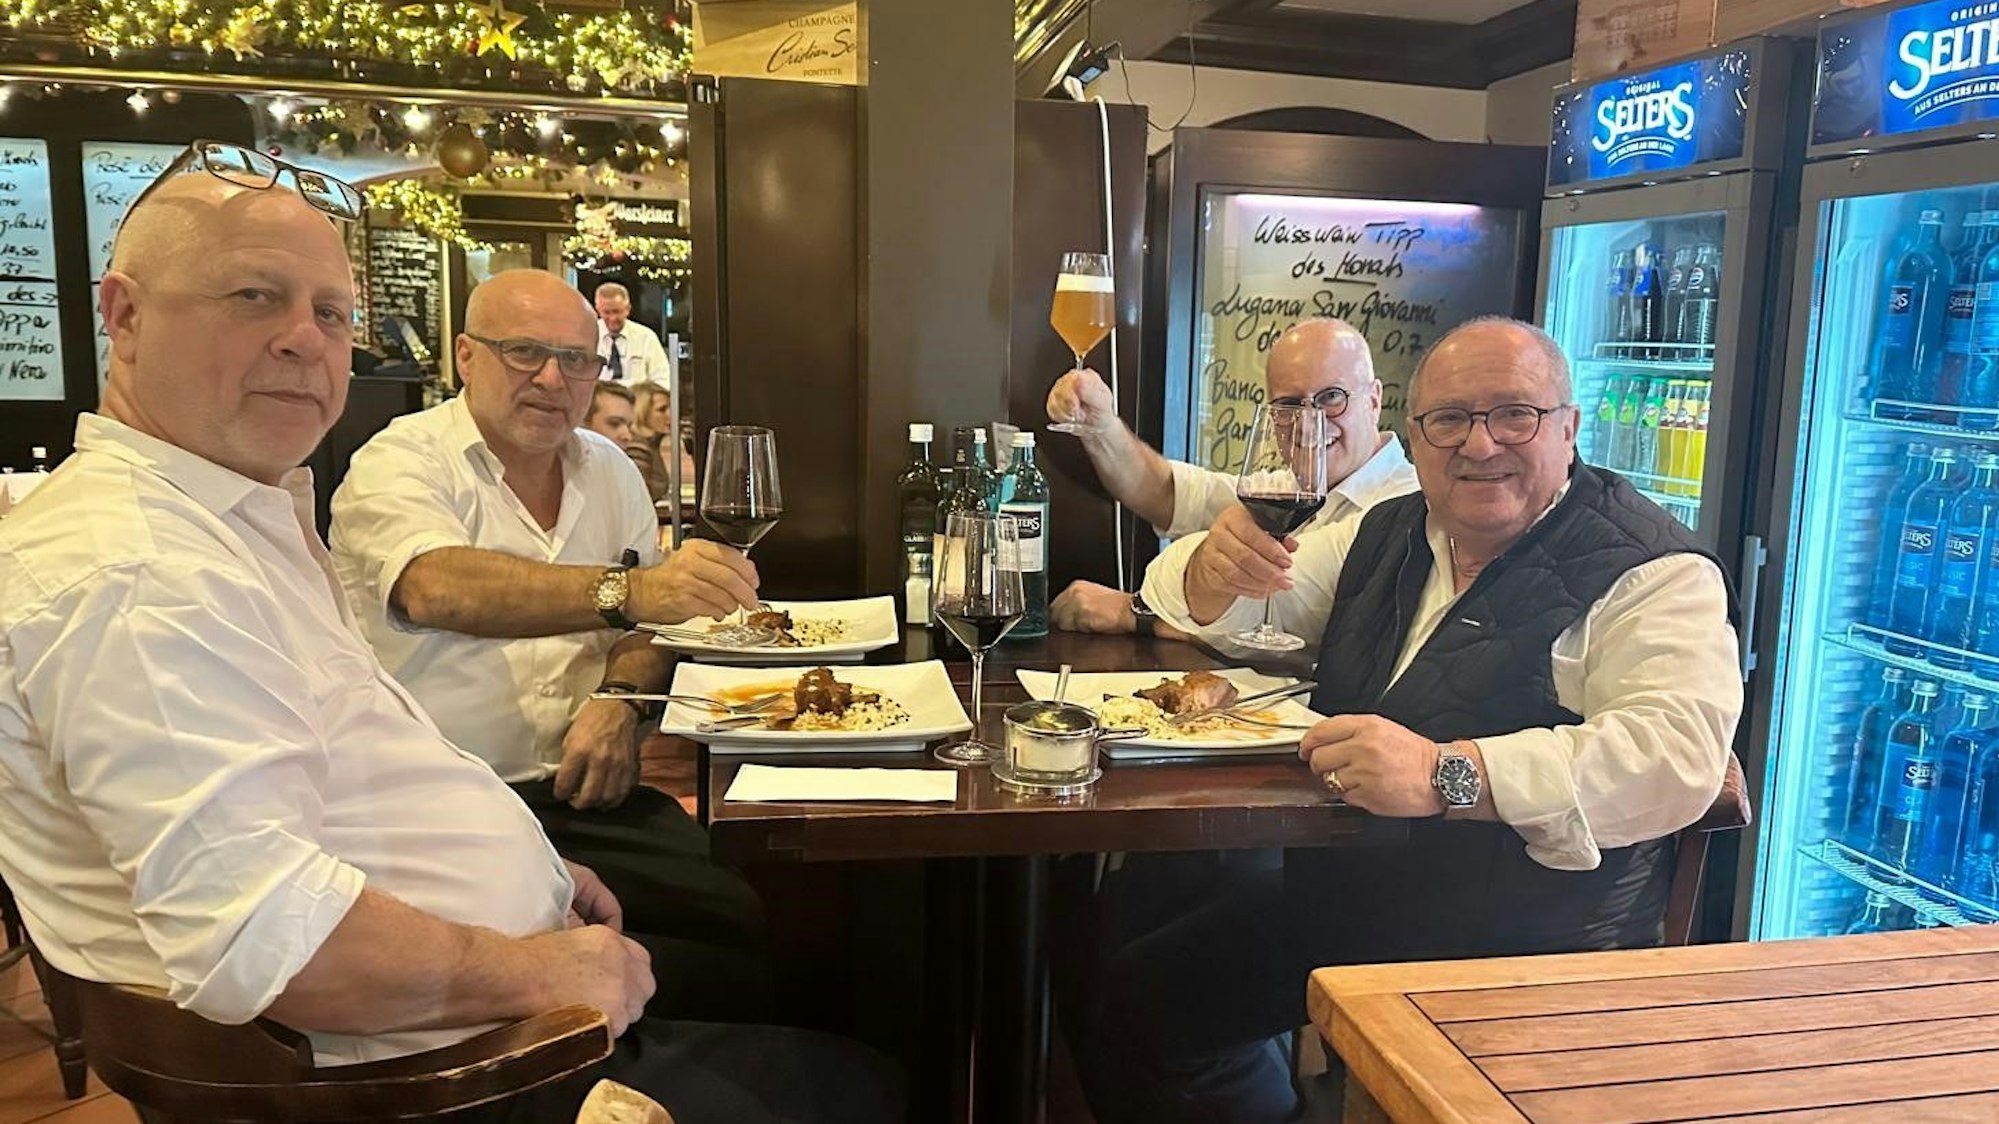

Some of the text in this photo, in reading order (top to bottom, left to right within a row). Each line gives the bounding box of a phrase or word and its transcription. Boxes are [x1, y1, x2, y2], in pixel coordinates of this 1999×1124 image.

[1592, 82, 1695, 152] SELTERS
[1914, 97, 1932, 115] AUS
[1933, 85, 1973, 105] SELTERS
[1973, 82, 1988, 94] AN
[1291, 251, 1326, 278] des
[1211, 283, 1306, 341] Lugana
[1204, 358, 1265, 405] Bianco
